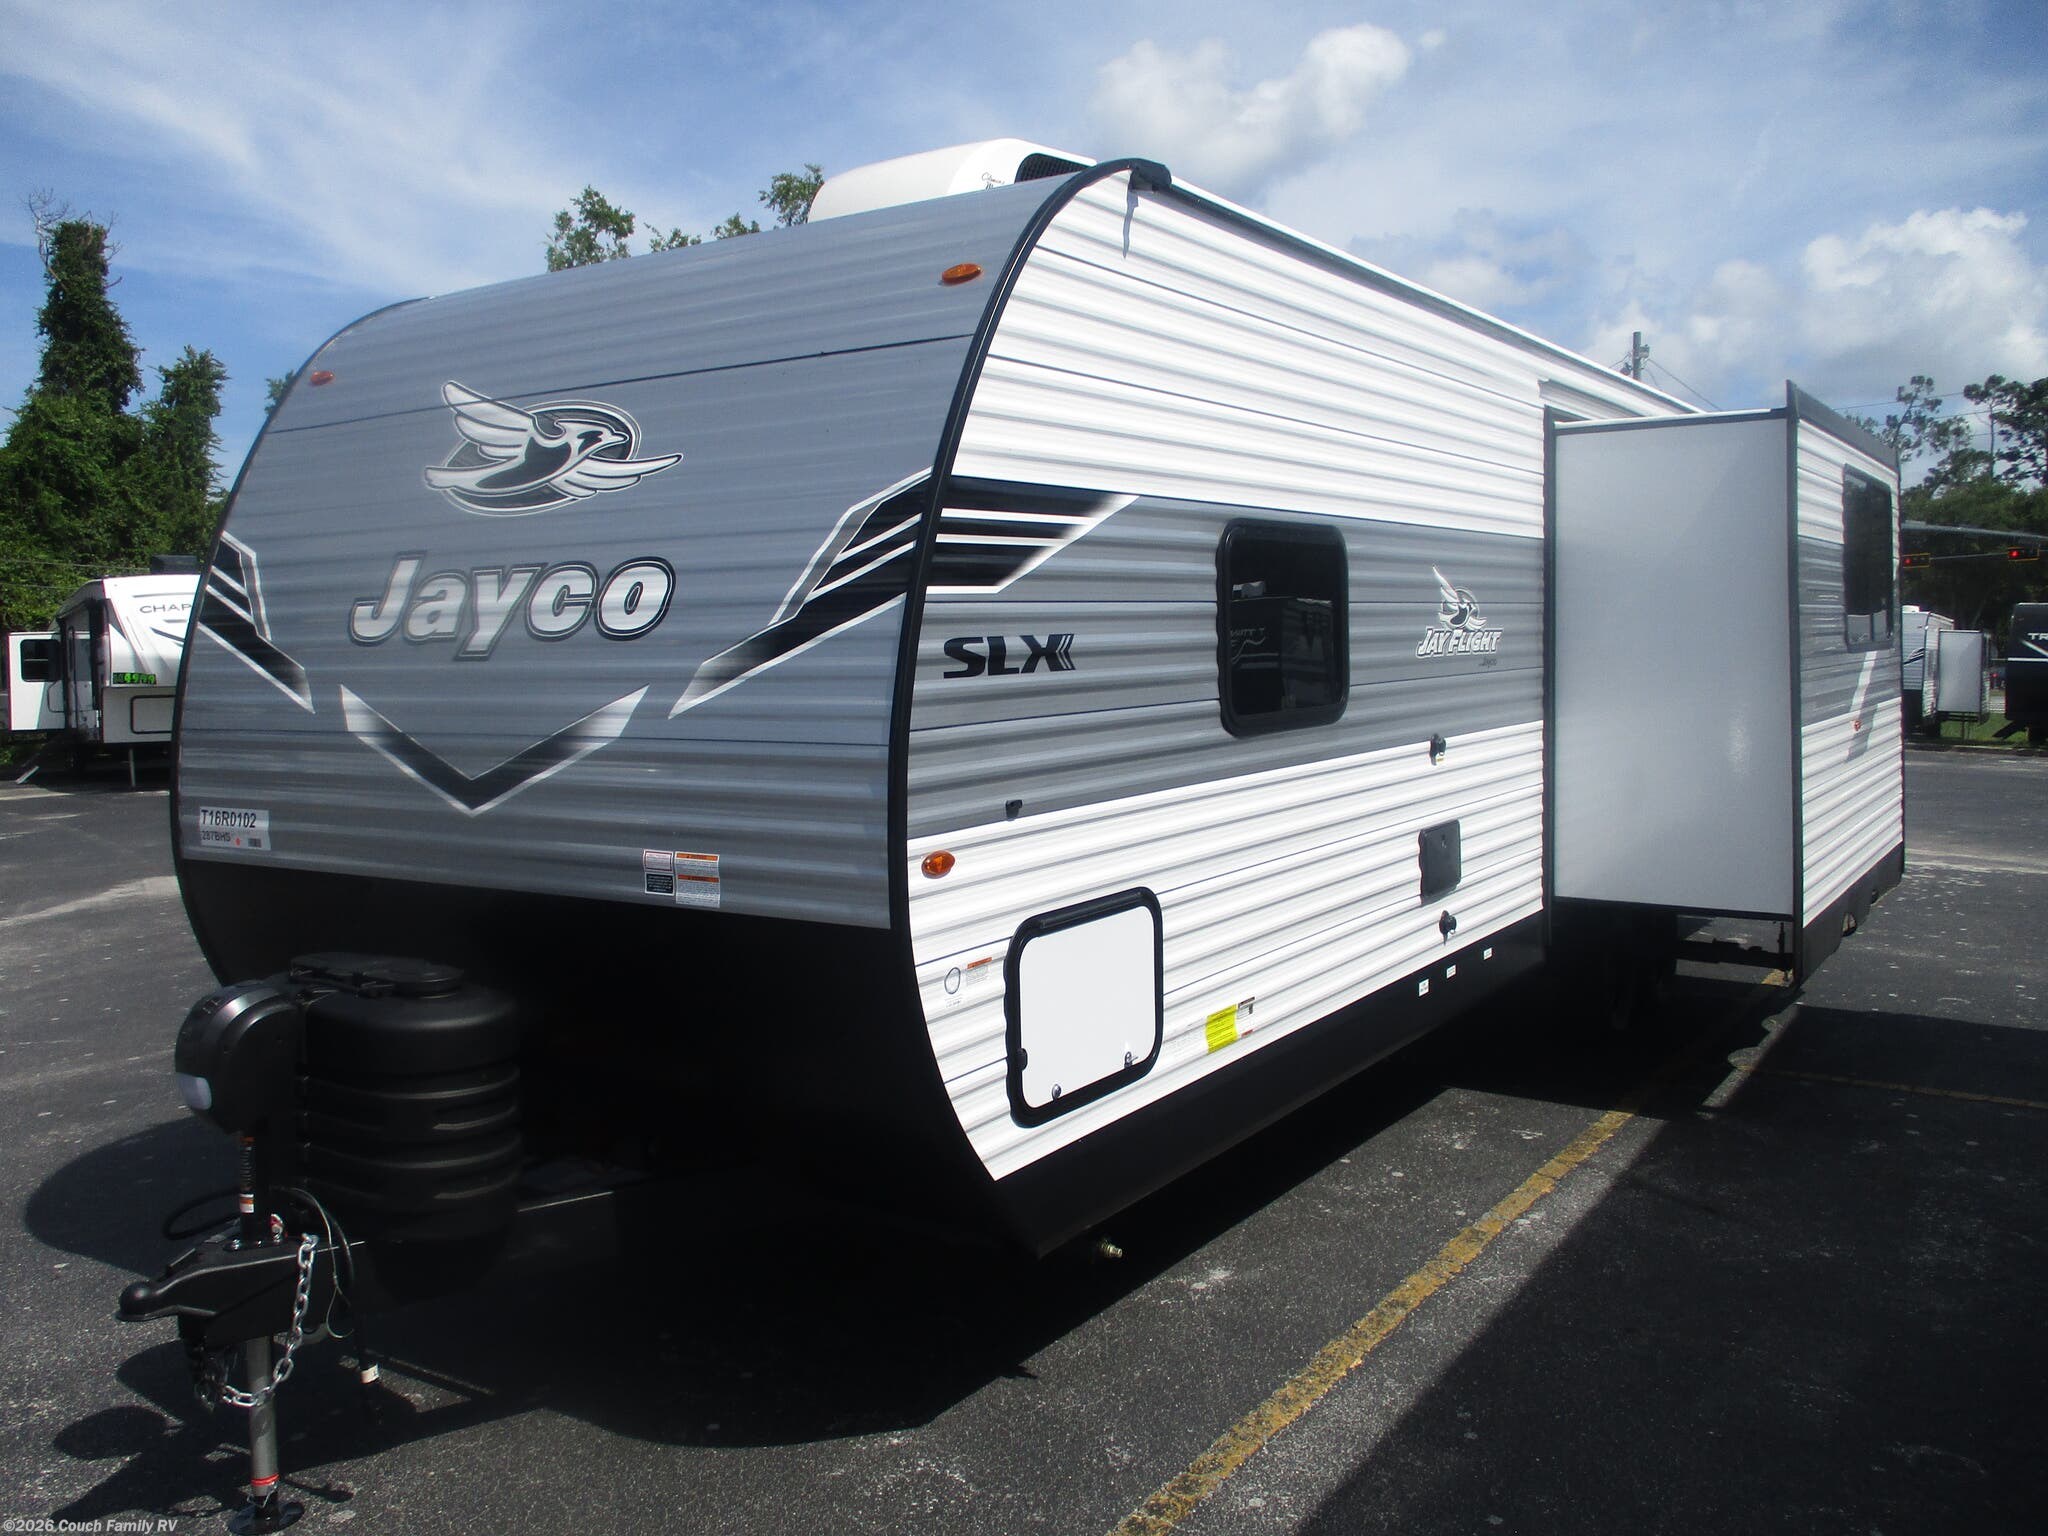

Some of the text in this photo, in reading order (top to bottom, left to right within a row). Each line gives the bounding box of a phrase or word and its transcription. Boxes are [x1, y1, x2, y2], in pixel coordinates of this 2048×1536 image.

[349, 550, 677, 661] Jayco
[943, 633, 1076, 679] SLX
[1416, 626, 1504, 659] JAY FLIGHT
[201, 809, 257, 829] T16R0102
